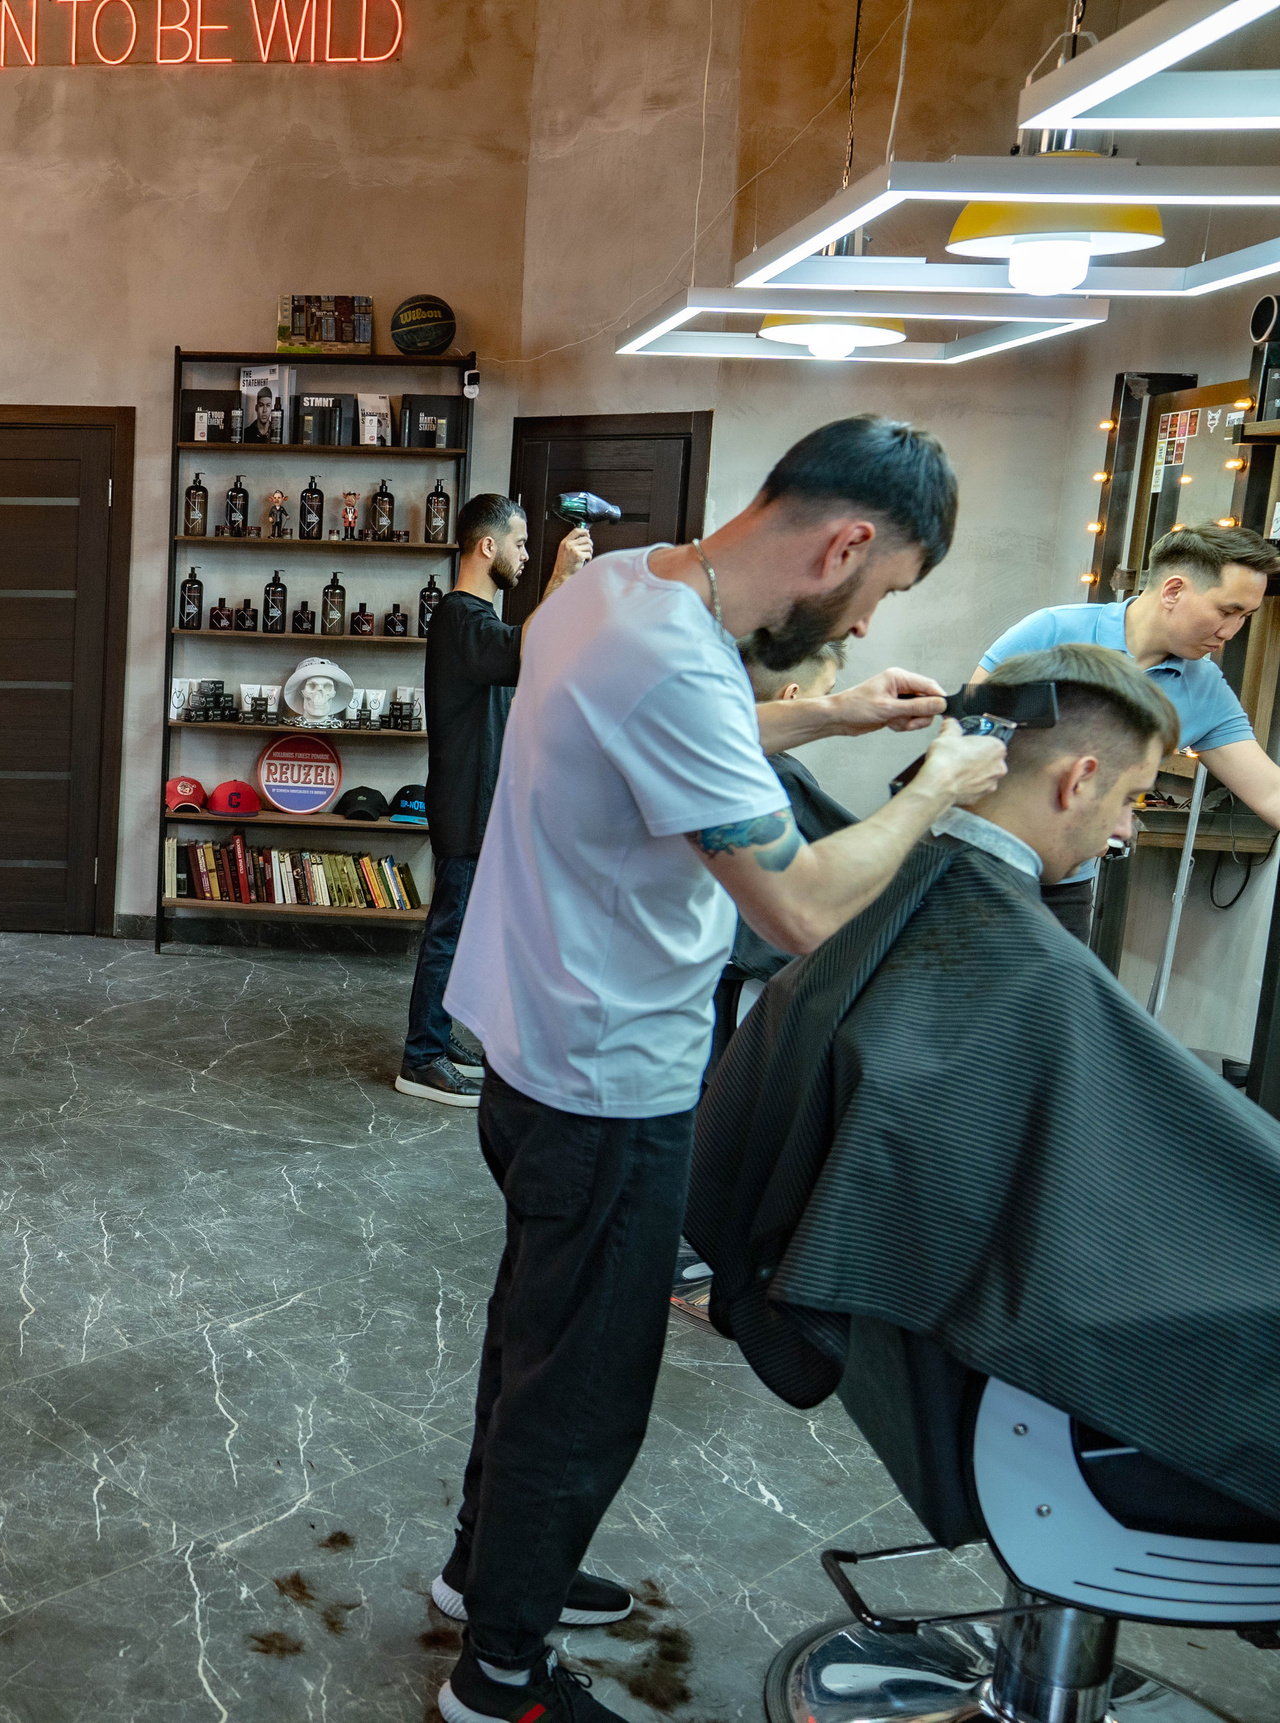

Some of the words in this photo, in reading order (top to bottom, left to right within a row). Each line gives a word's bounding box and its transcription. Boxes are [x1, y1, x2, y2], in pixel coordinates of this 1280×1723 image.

[56, 0, 138, 66] TO
[156, 0, 233, 64] BE
[250, 0, 404, 64] WILD
[399, 307, 443, 325] Wilson
[242, 370, 252, 378] THE
[242, 378, 269, 387] STATEMENT
[303, 396, 335, 408] STMNT
[265, 762, 335, 786] REUZEL
[228, 792, 242, 809] C
